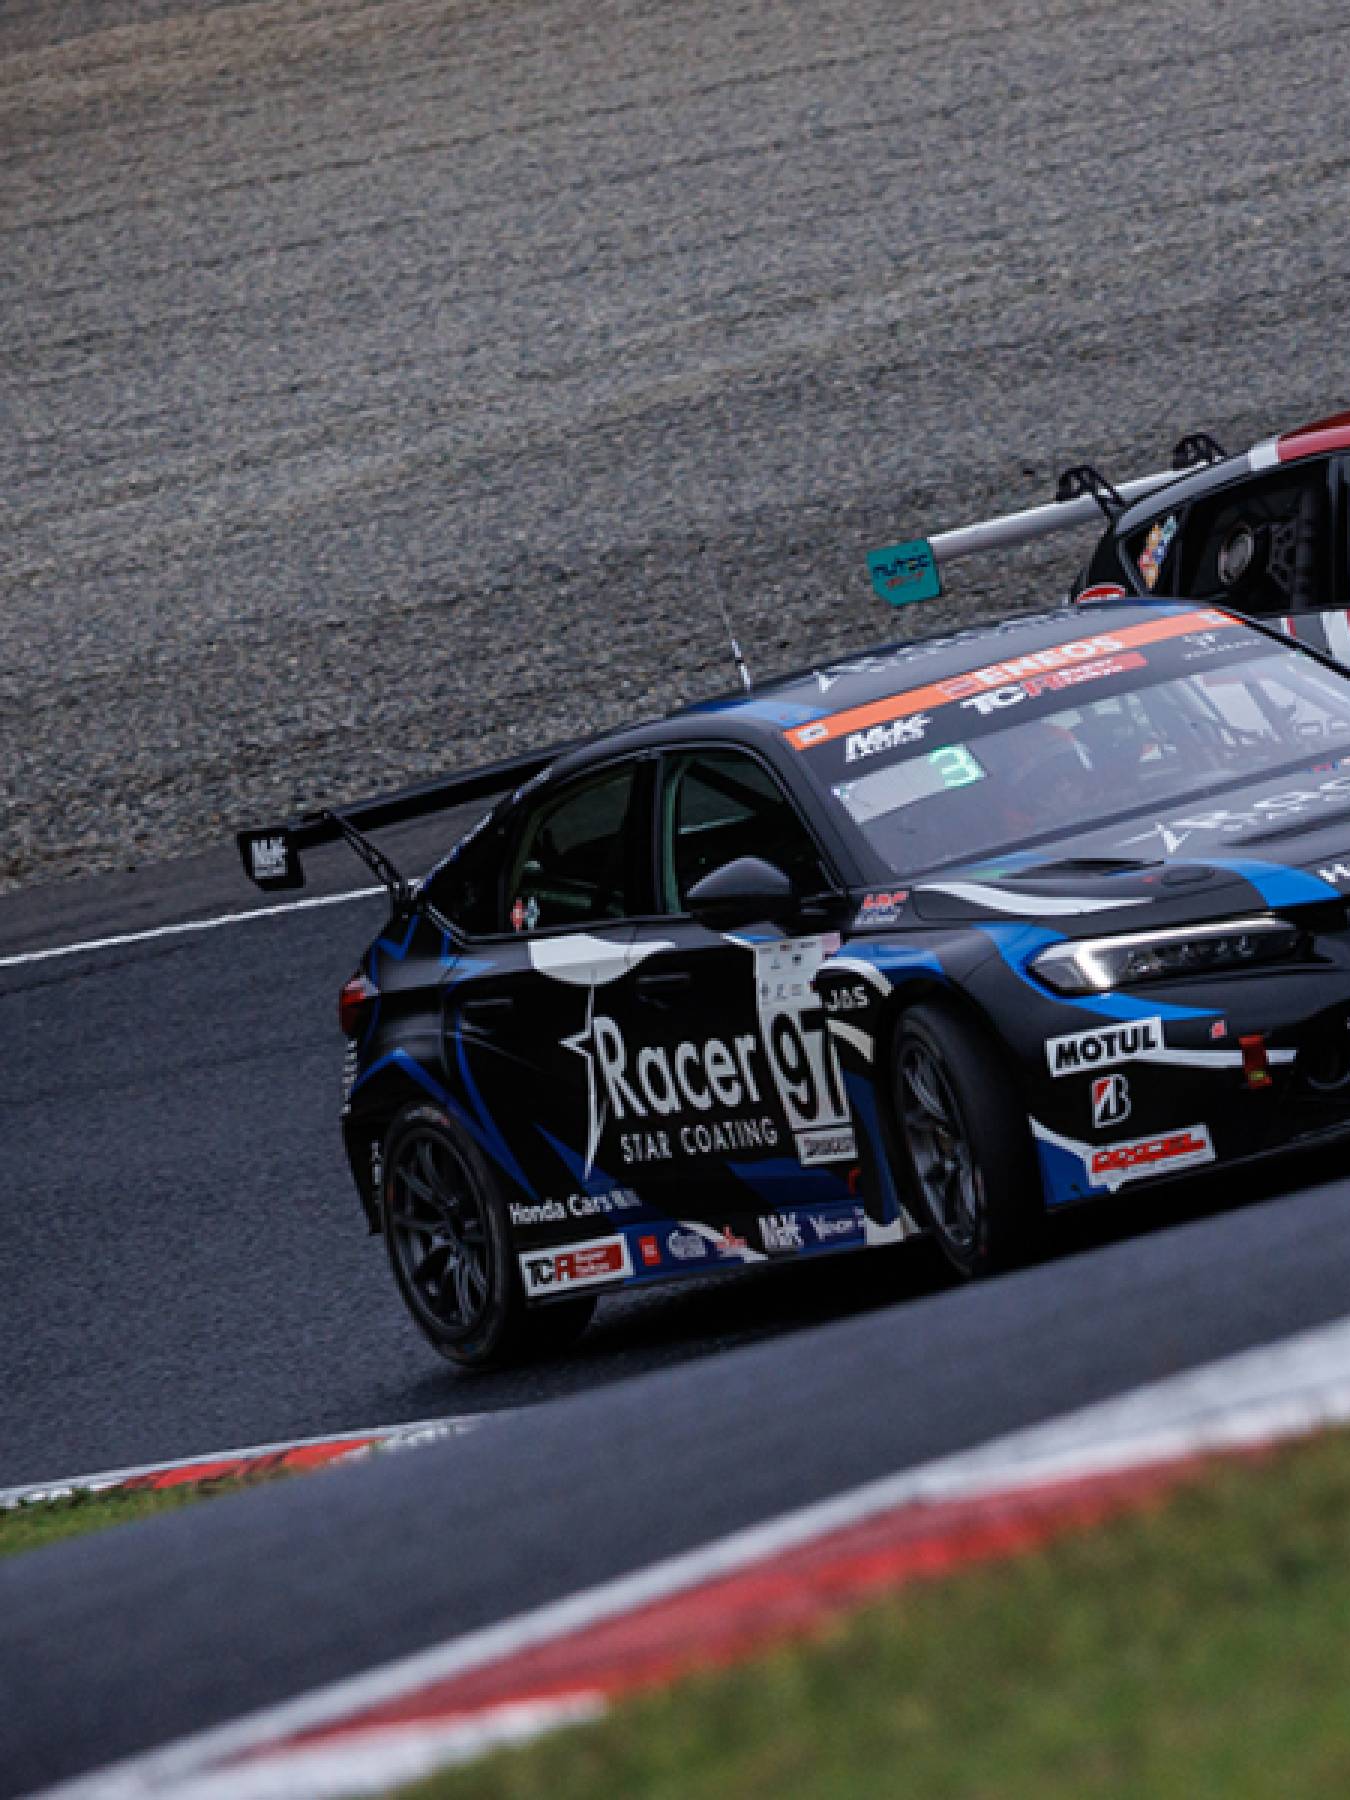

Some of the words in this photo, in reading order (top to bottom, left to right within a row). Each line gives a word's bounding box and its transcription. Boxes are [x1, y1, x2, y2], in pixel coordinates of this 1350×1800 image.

[975, 635, 1125, 685] ENEOS
[928, 744, 982, 788] 3
[594, 1015, 762, 1120] Racer
[771, 1009, 845, 1121] 97
[1055, 1025, 1158, 1069] MOTUL
[620, 1129, 673, 1164] STAR
[680, 1117, 779, 1157] COATING
[508, 1198, 567, 1227] Honda
[525, 1255, 576, 1286] TCR
